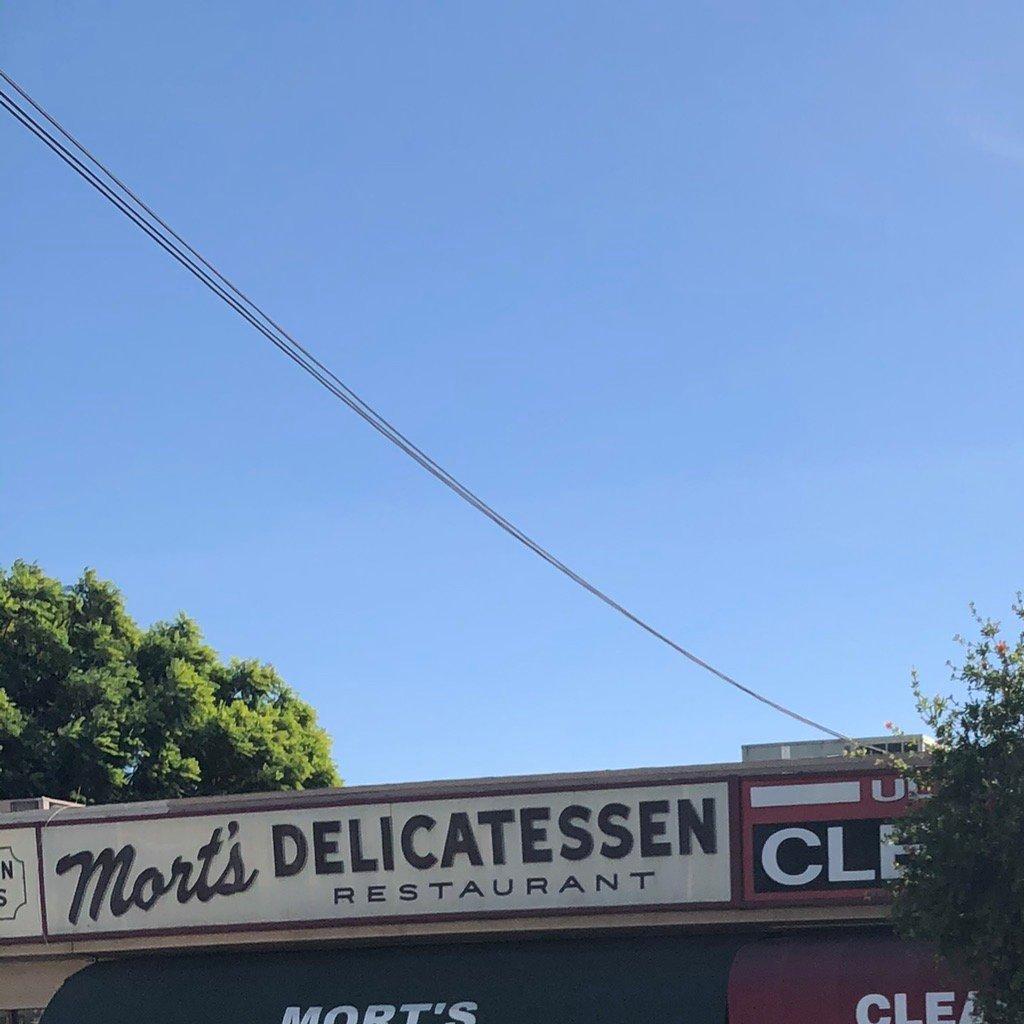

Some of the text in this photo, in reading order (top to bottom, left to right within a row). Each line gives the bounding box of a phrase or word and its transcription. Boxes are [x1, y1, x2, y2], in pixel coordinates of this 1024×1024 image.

[55, 798, 719, 927] Mort's DELICATESSEN
[334, 871, 656, 905] RESTAURANT
